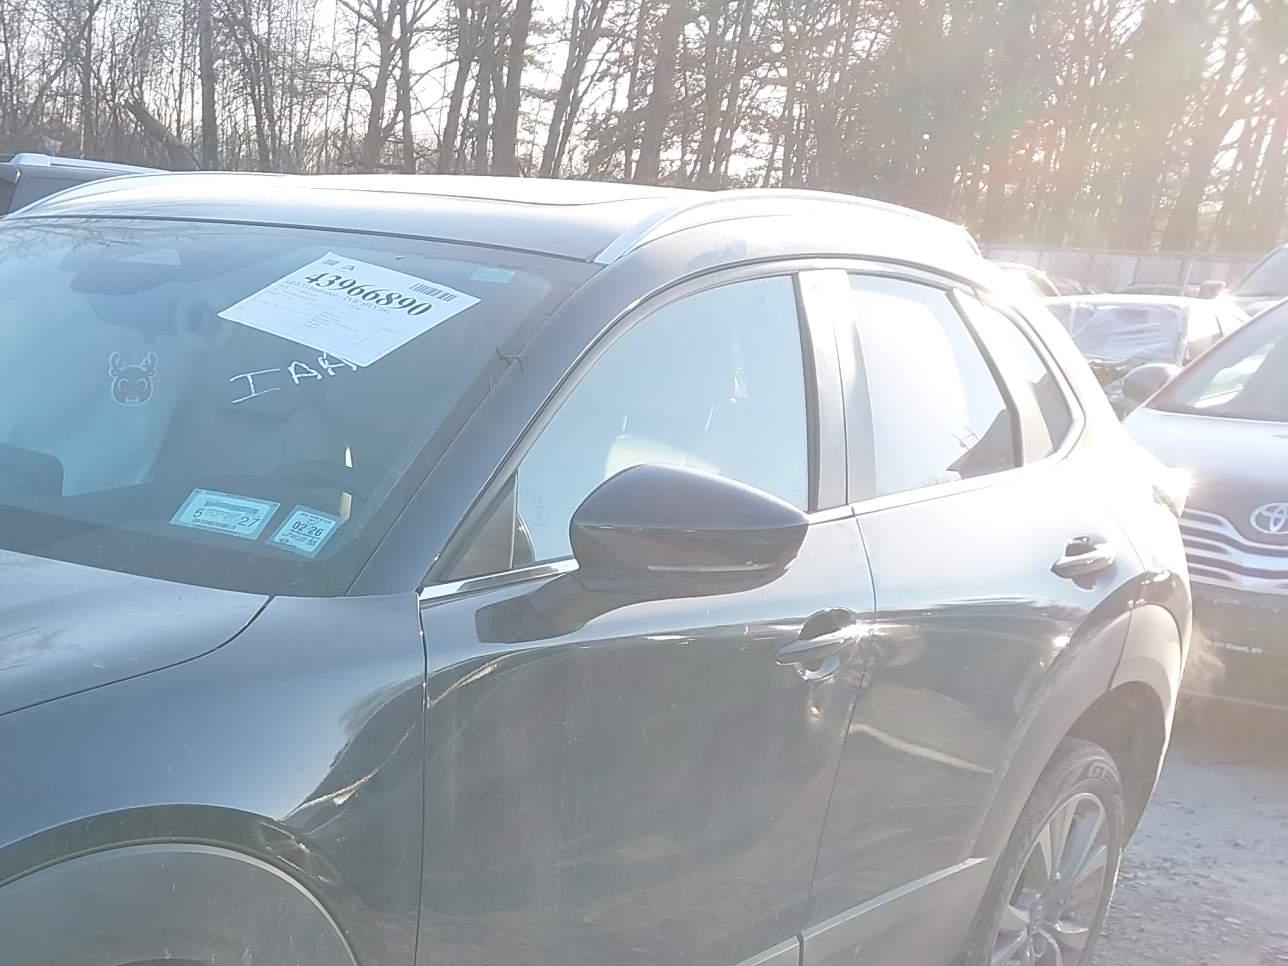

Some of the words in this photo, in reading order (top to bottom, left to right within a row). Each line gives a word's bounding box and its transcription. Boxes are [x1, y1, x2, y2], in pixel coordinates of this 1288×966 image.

[304, 271, 433, 316] 43966890
[192, 508, 205, 518] 5
[237, 516, 262, 528] 27
[291, 521, 308, 532] 02
[307, 525, 324, 537] 26
